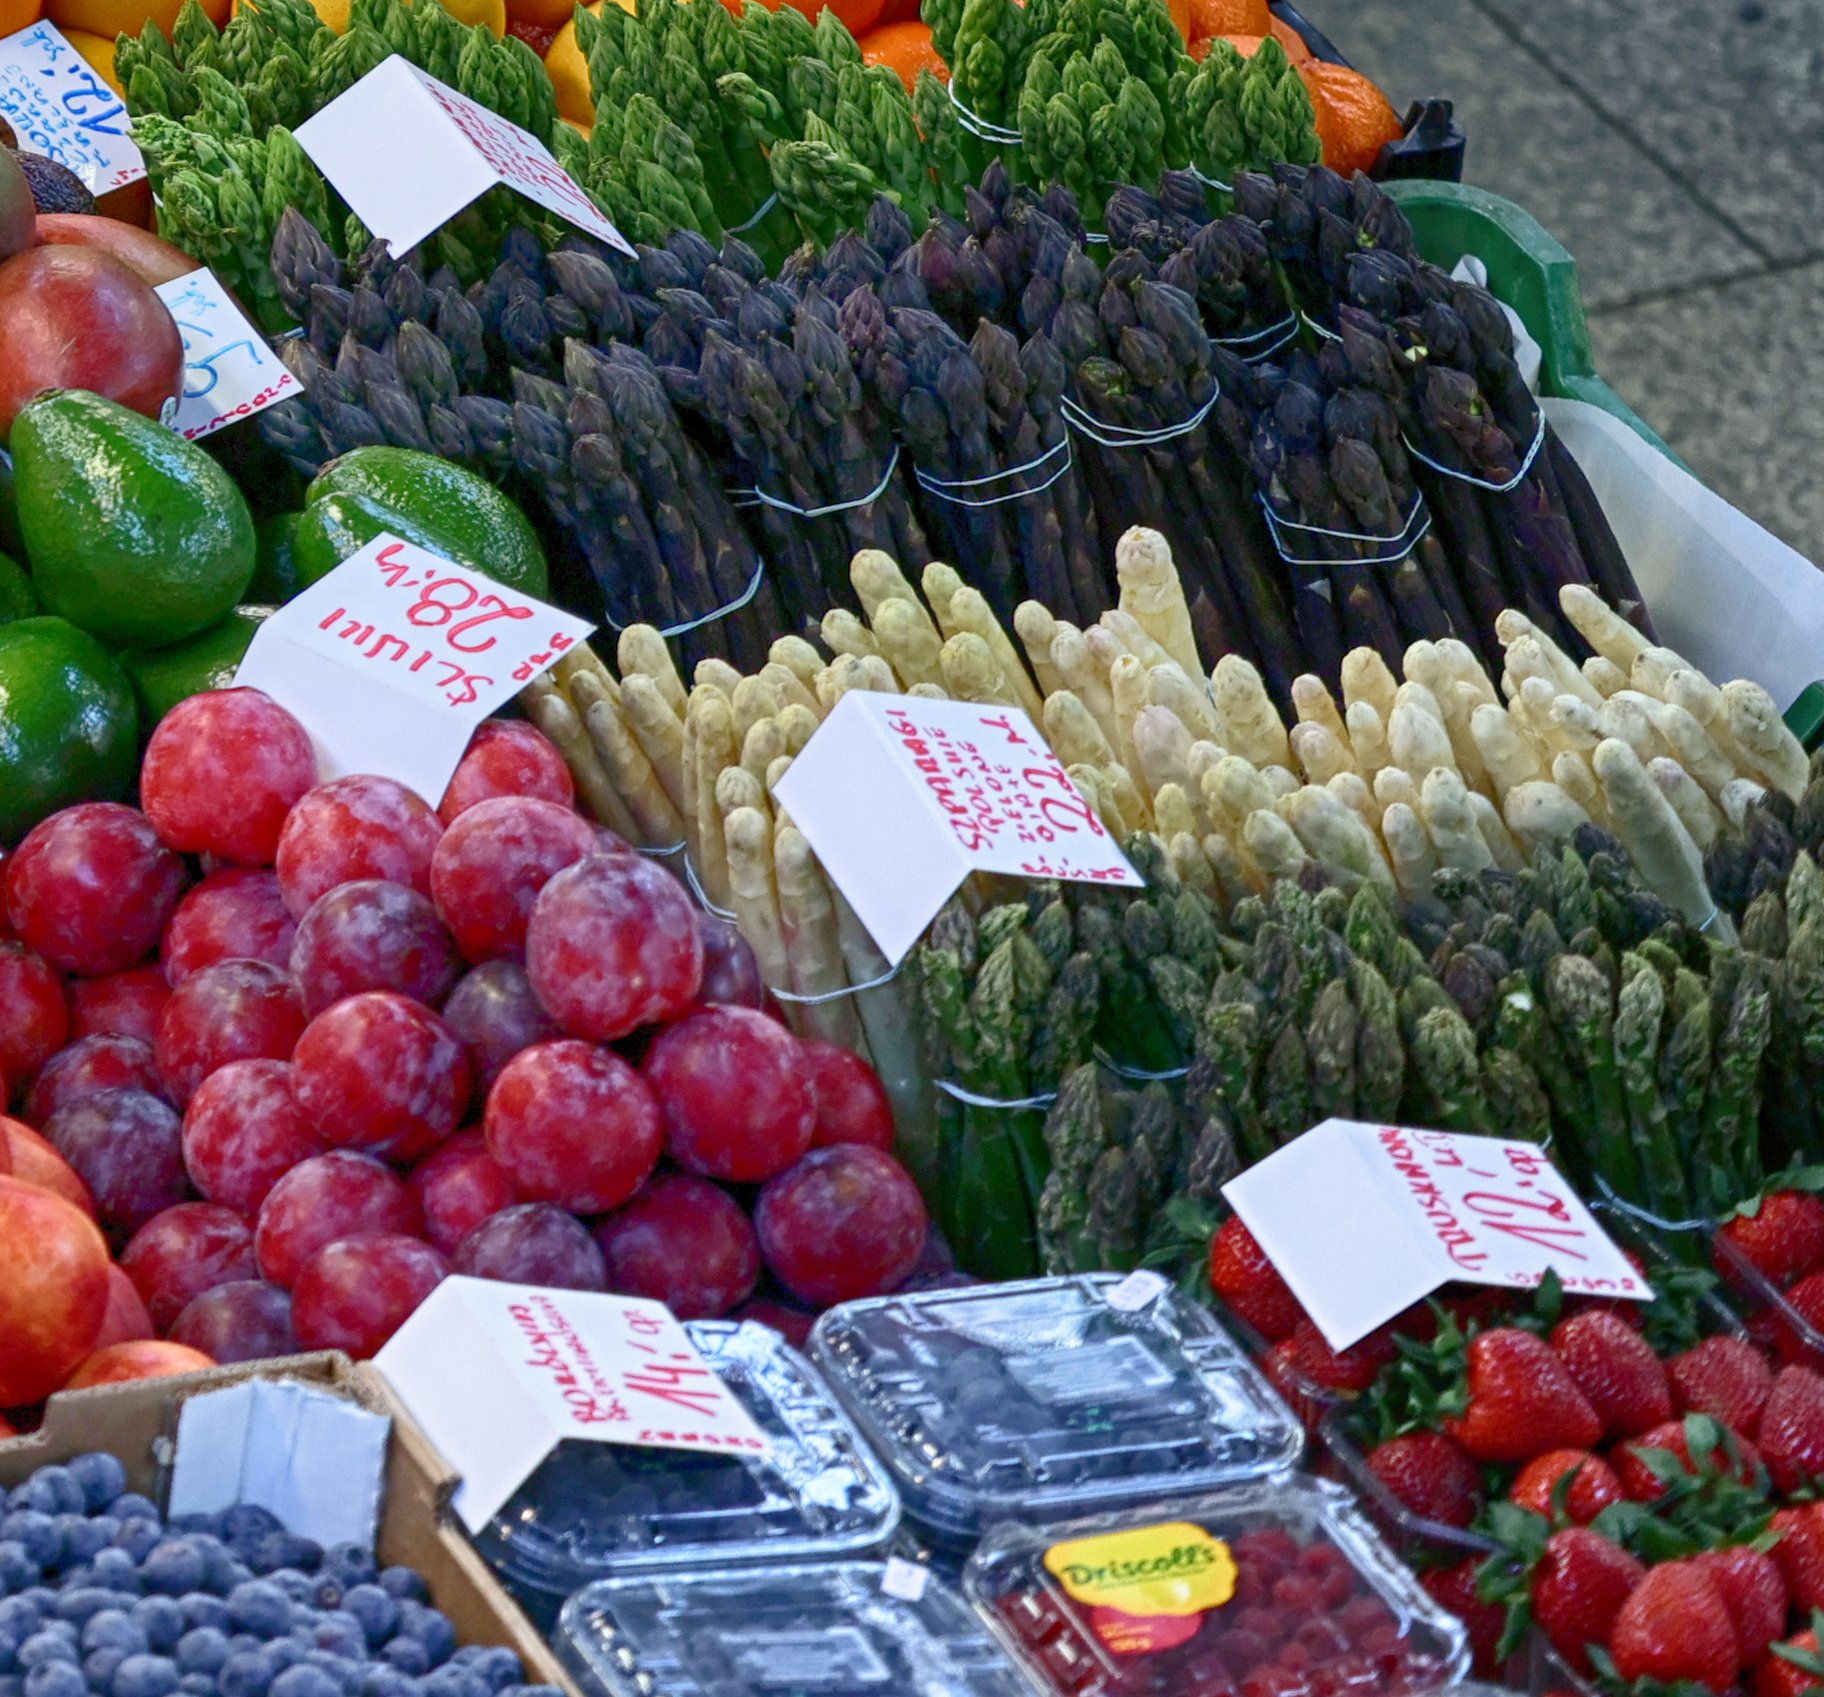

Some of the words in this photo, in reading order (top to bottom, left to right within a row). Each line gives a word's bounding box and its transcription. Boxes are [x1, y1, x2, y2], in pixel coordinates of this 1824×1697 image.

[512, 632, 574, 681] RPA
[890, 710, 984, 851] SZPARAGI
[1062, 1543, 1216, 1586] Driscoll's
